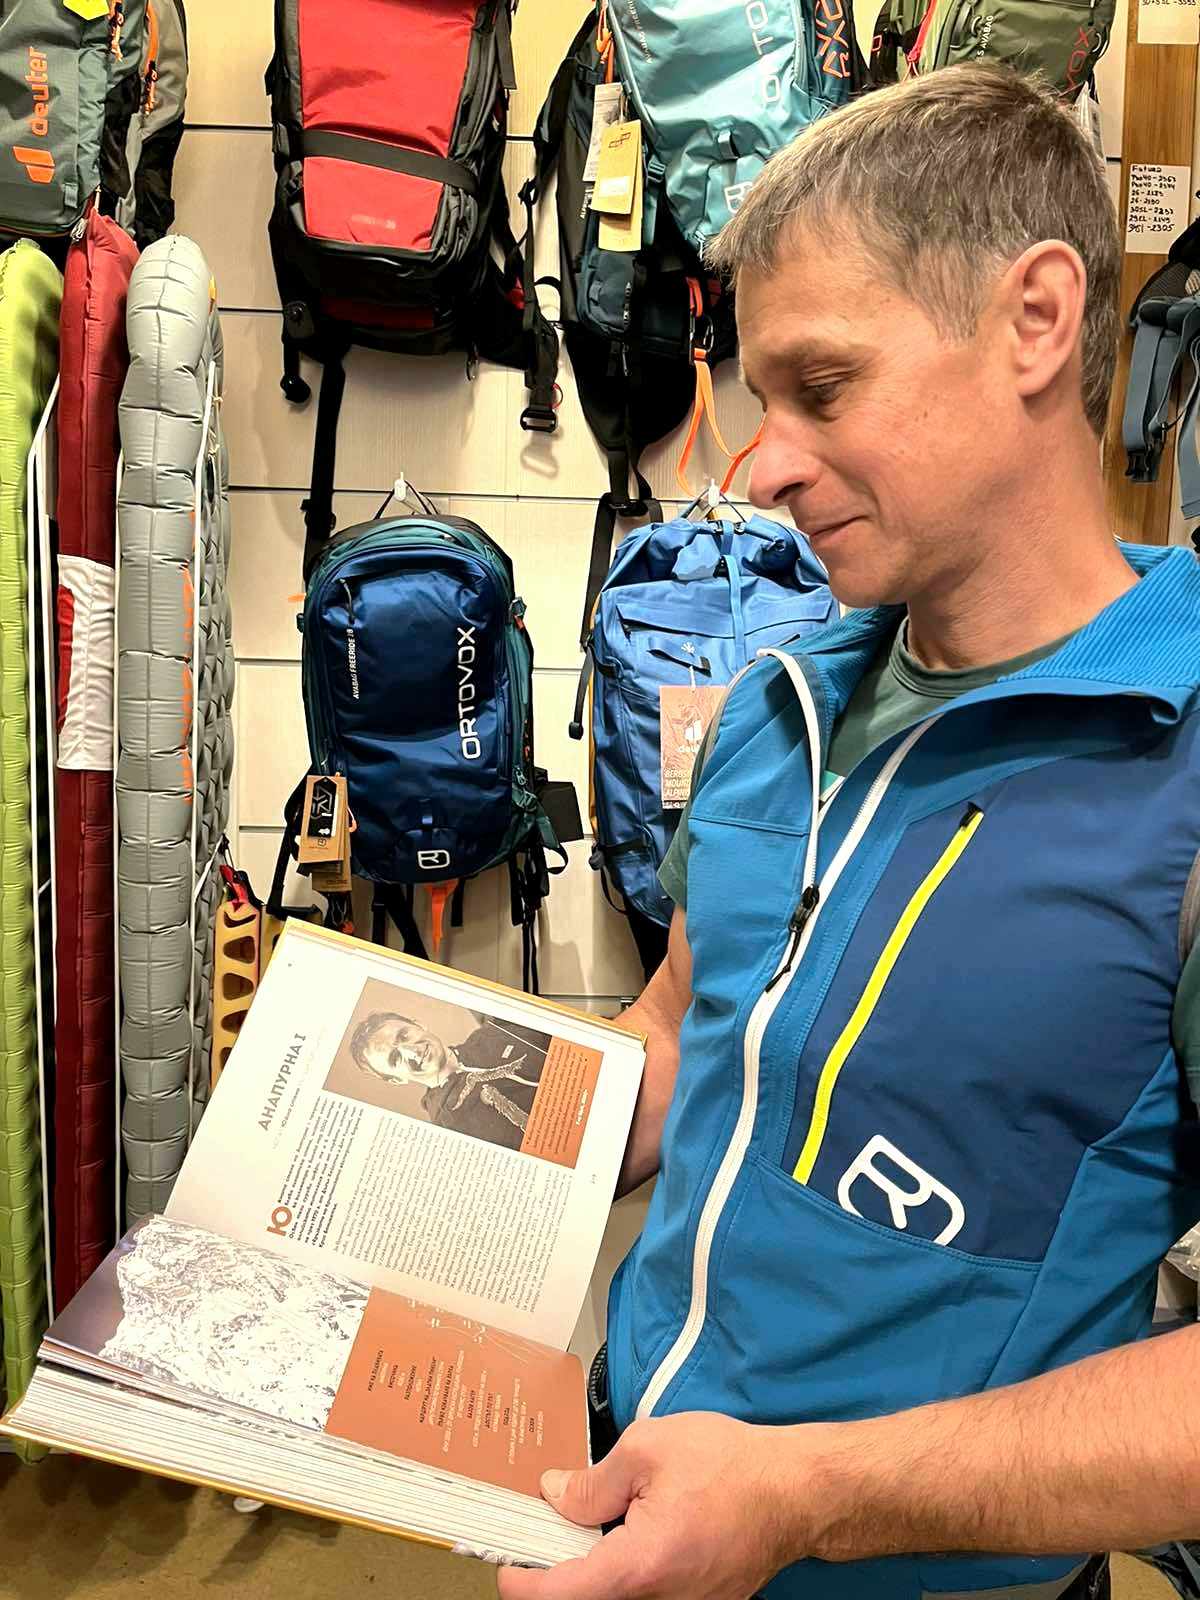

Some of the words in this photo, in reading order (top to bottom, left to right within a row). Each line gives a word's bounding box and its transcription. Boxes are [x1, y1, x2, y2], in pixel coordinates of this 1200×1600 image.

[25, 46, 49, 136] deuter
[457, 626, 481, 759] ORTOVOX
[258, 1042, 302, 1131] АНАПУРНА
